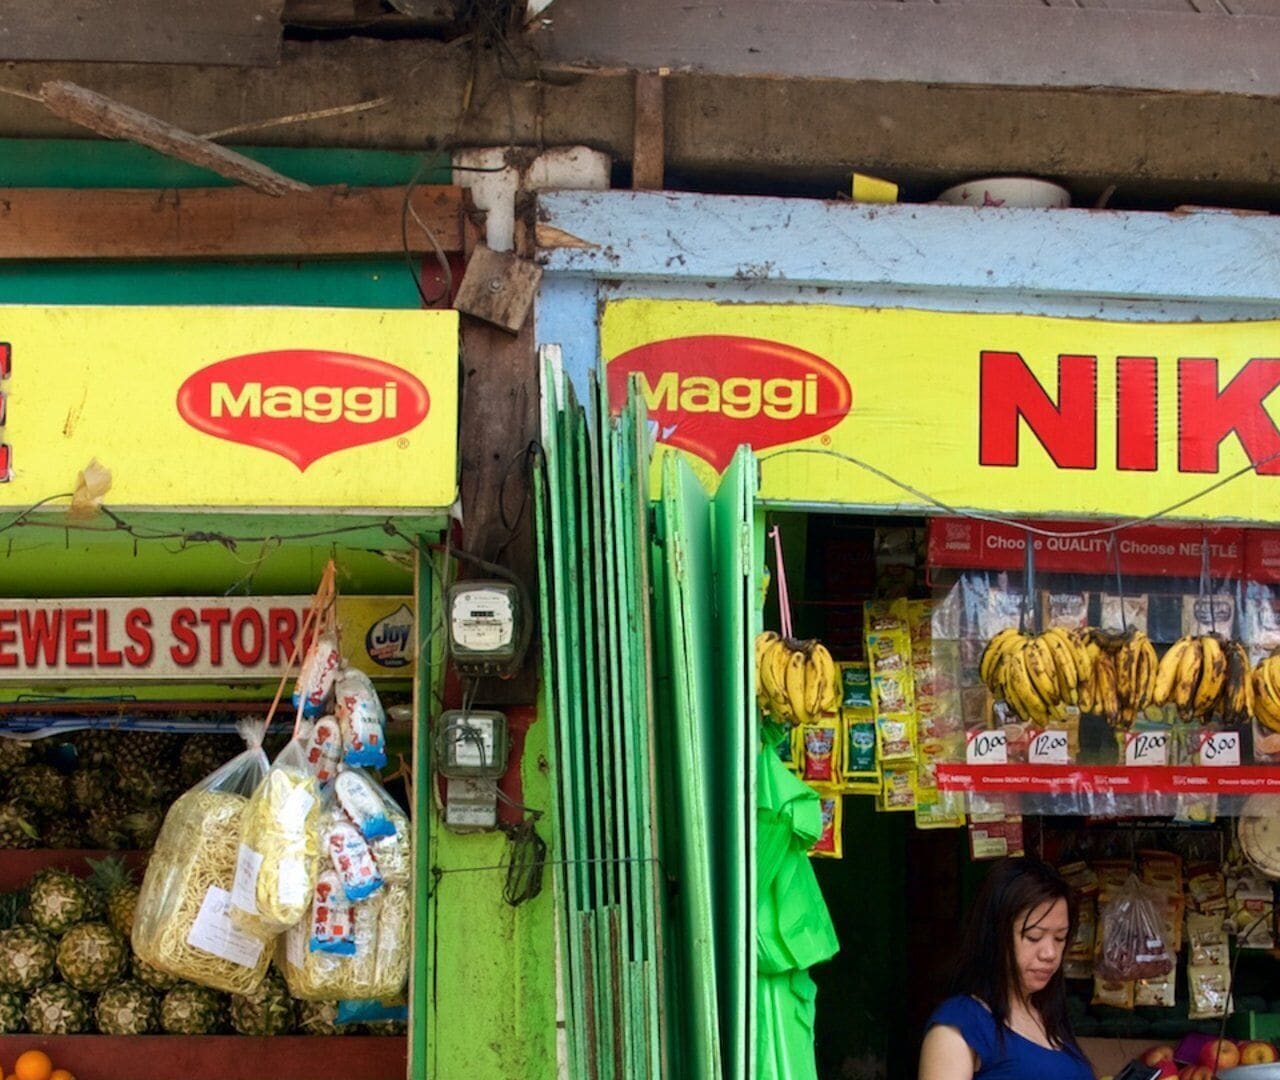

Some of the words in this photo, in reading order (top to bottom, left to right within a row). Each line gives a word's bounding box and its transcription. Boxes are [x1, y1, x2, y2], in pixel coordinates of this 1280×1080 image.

[210, 381, 398, 425] Maggi
[632, 369, 819, 421] Maggi
[986, 534, 1041, 550] Chooe
[1120, 539, 1175, 556] Choose
[973, 735, 1007, 757] 10.00
[1035, 735, 1067, 757] 12.00
[1134, 734, 1167, 760] 12.00
[1205, 736, 1236, 759] 8.00
